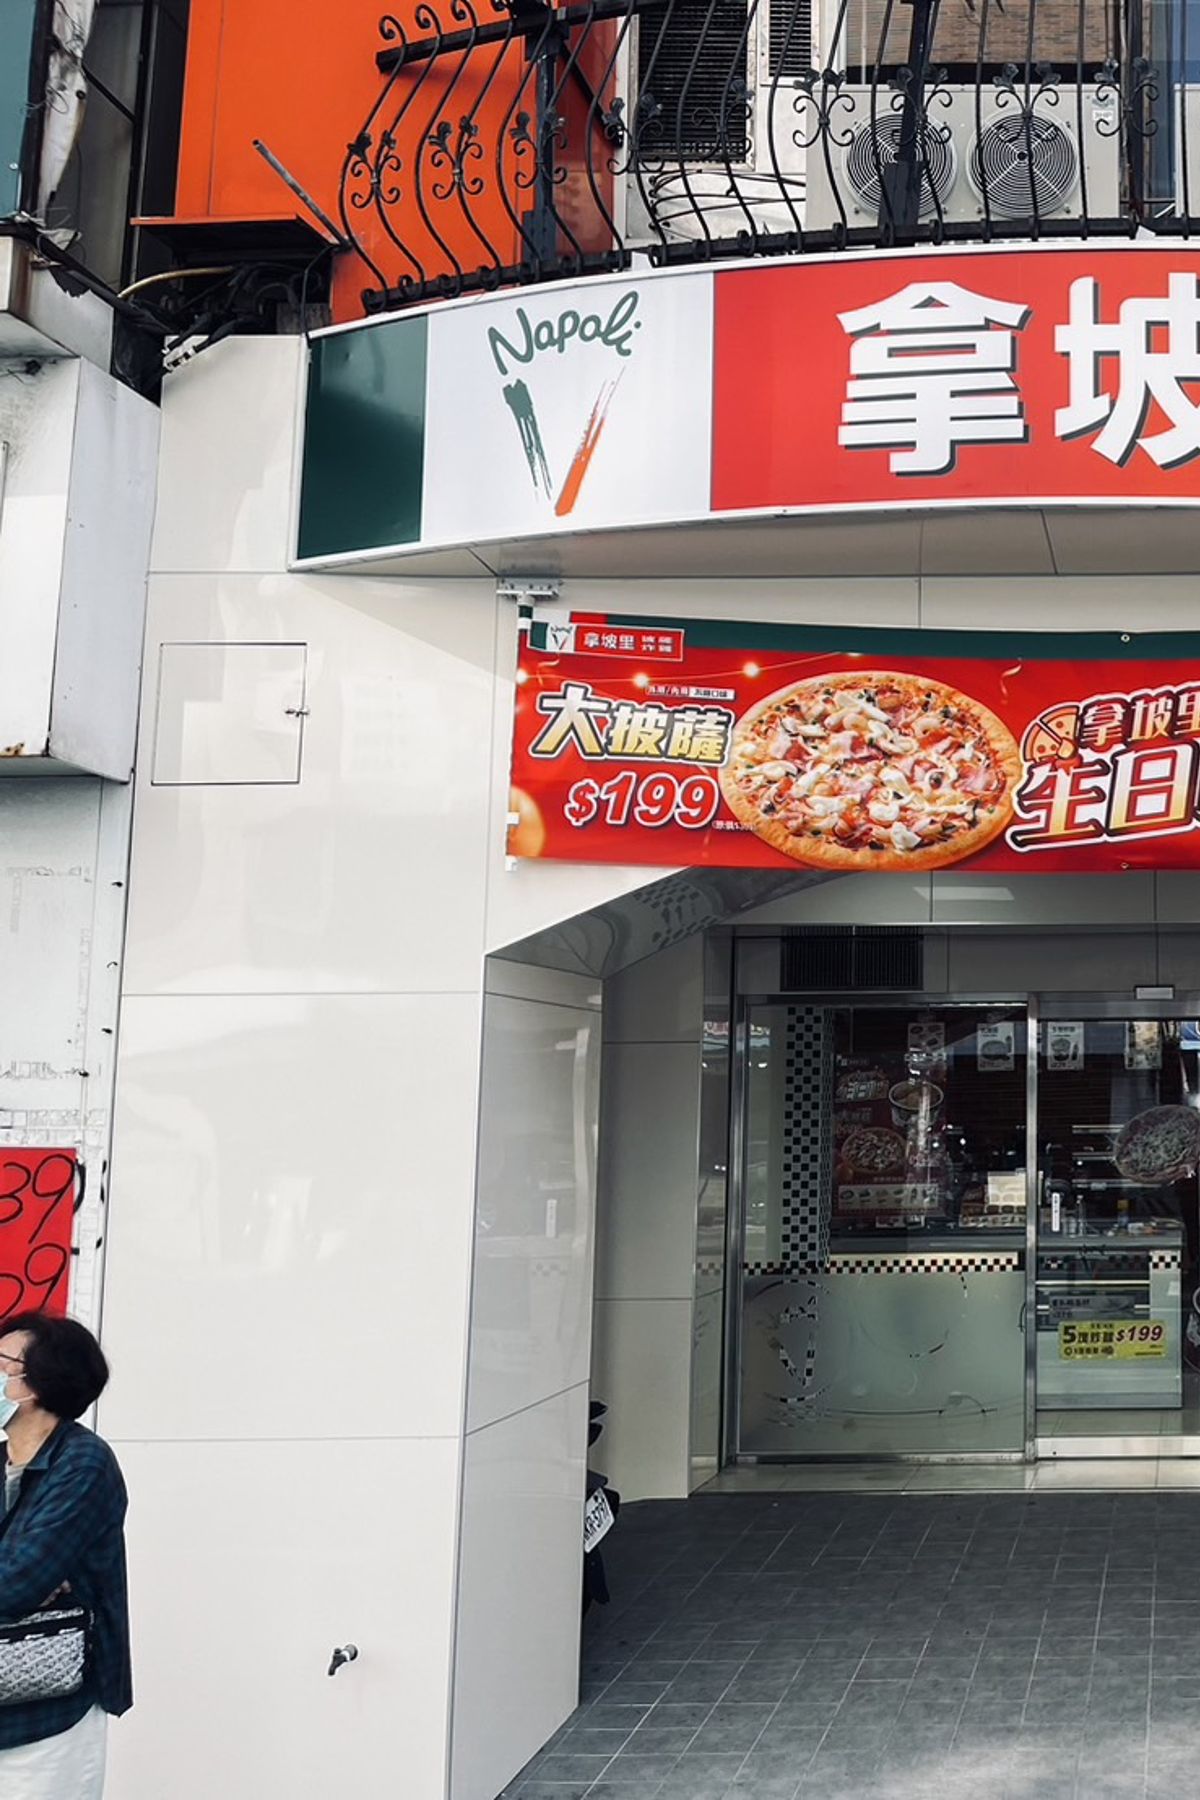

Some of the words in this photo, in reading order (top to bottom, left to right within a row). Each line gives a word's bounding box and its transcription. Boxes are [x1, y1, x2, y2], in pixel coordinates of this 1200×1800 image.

[488, 291, 642, 376] Napoli
[534, 683, 731, 764] 大披薩
[564, 771, 719, 828] $199
[1116, 1325, 1164, 1343] $199
